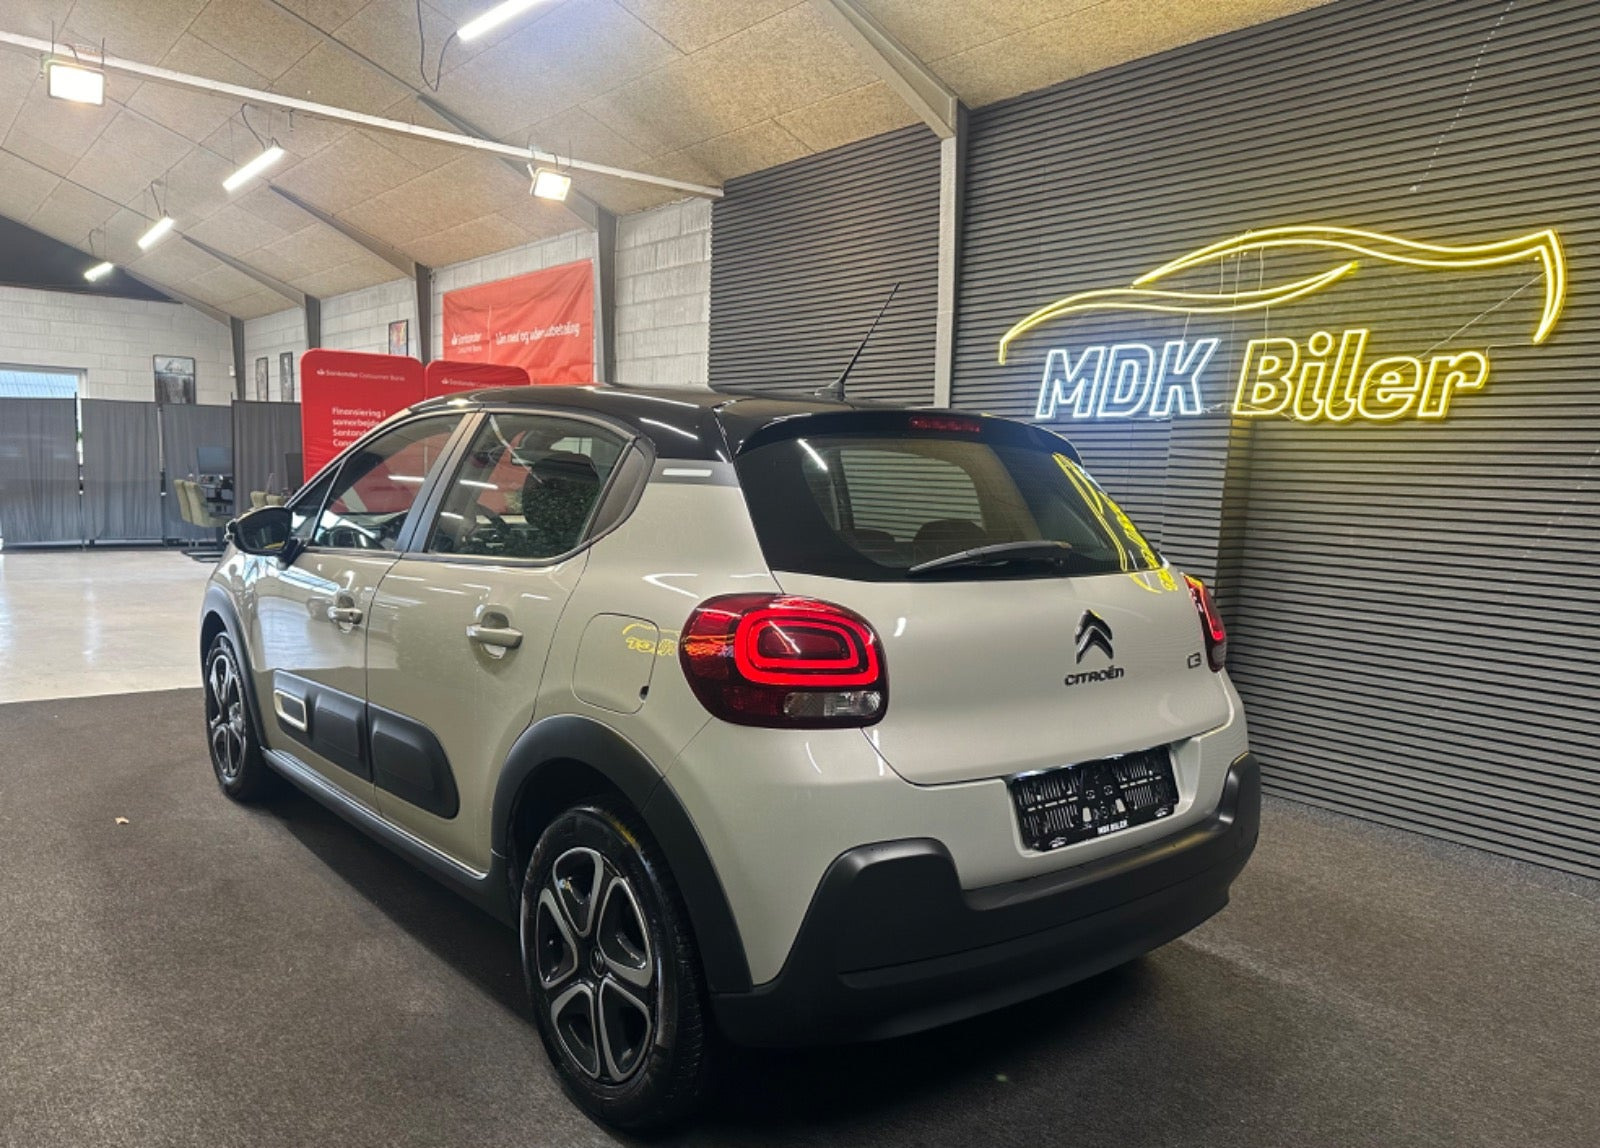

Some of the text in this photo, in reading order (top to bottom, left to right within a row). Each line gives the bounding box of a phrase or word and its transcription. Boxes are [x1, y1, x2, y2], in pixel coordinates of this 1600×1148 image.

[1035, 328, 1491, 422] MDK Biler
[332, 407, 381, 419] Finansiering
[332, 429, 368, 437] Santand
[1187, 652, 1202, 669] C3
